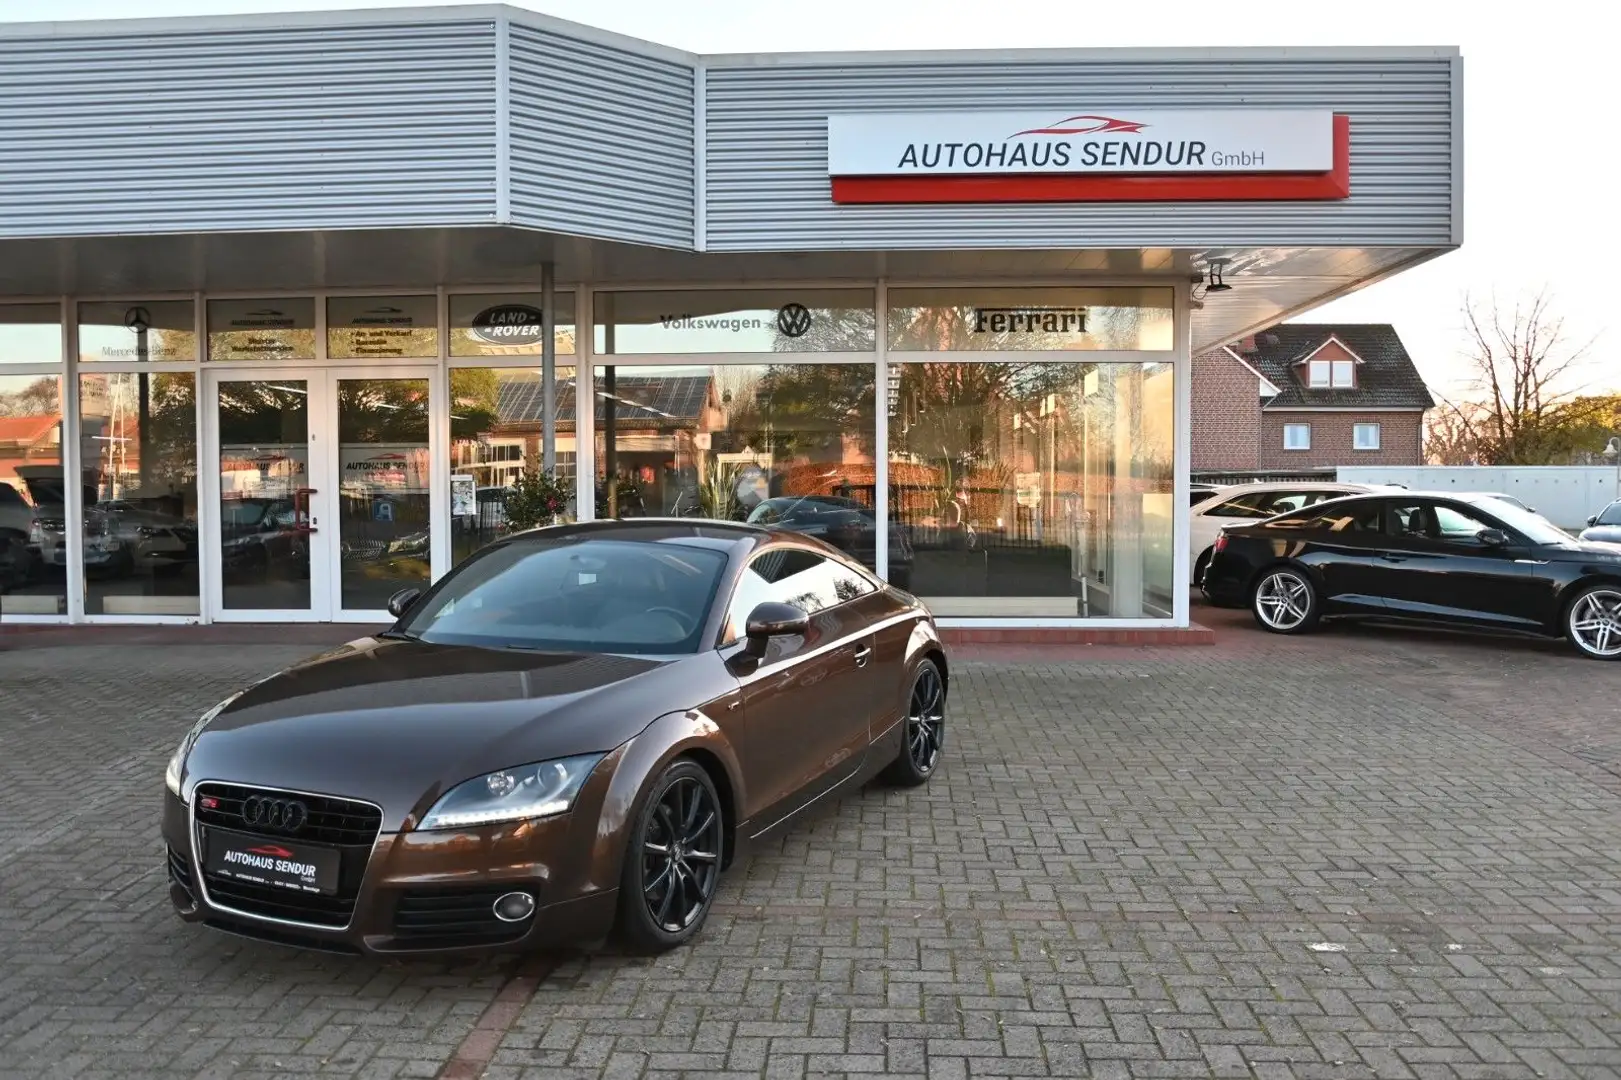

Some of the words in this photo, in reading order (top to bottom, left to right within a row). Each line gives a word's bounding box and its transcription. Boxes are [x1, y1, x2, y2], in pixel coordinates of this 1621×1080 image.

[898, 142, 1071, 168] AUTOHAUS
[1081, 141, 1206, 167] SENDUR
[1211, 151, 1264, 167] GmbH
[490, 311, 527, 324] LAND
[660, 314, 761, 332] Volkswagen
[974, 307, 1087, 333] Ferrari
[492, 325, 540, 337] ROVER
[223, 850, 275, 870] AUTOHAUS
[275, 860, 317, 877] SENDUR
